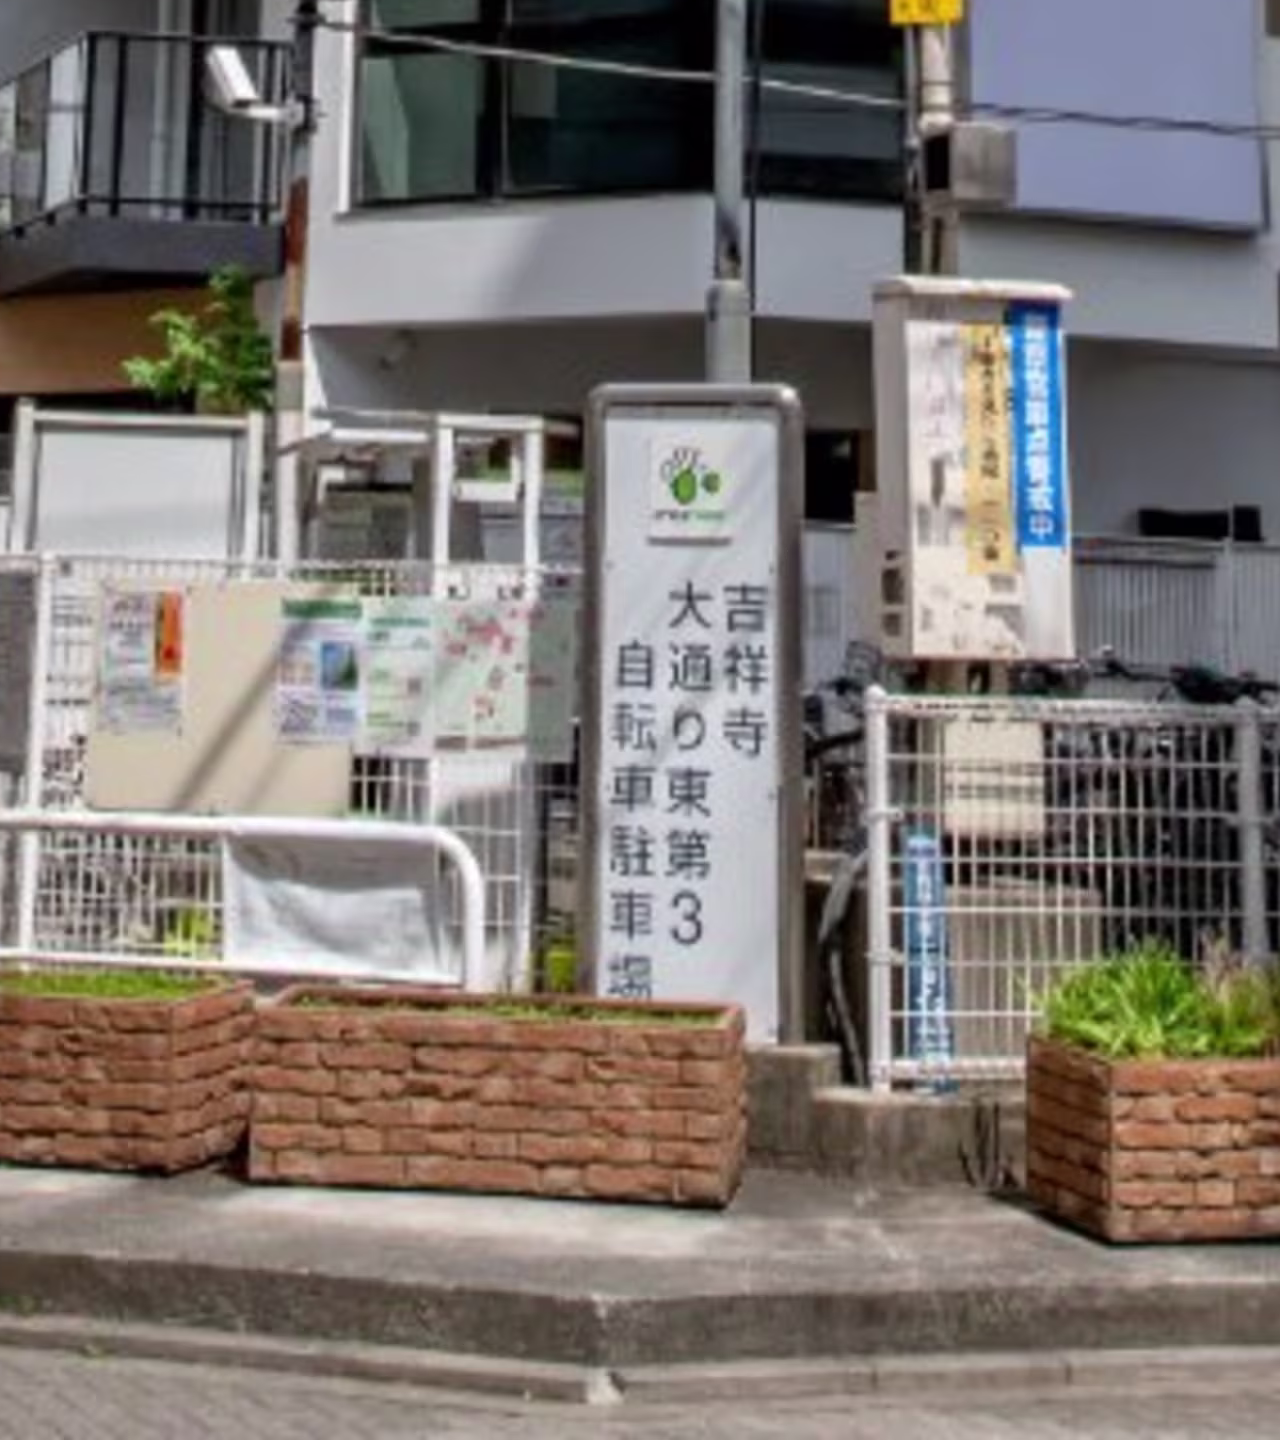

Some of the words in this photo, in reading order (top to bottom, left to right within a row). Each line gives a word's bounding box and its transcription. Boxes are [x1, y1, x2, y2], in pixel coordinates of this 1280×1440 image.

[607, 640, 658, 1001] 自転車駐車場
[665, 581, 714, 946] 大通り東第3
[723, 583, 770, 758] 吉祥寺
